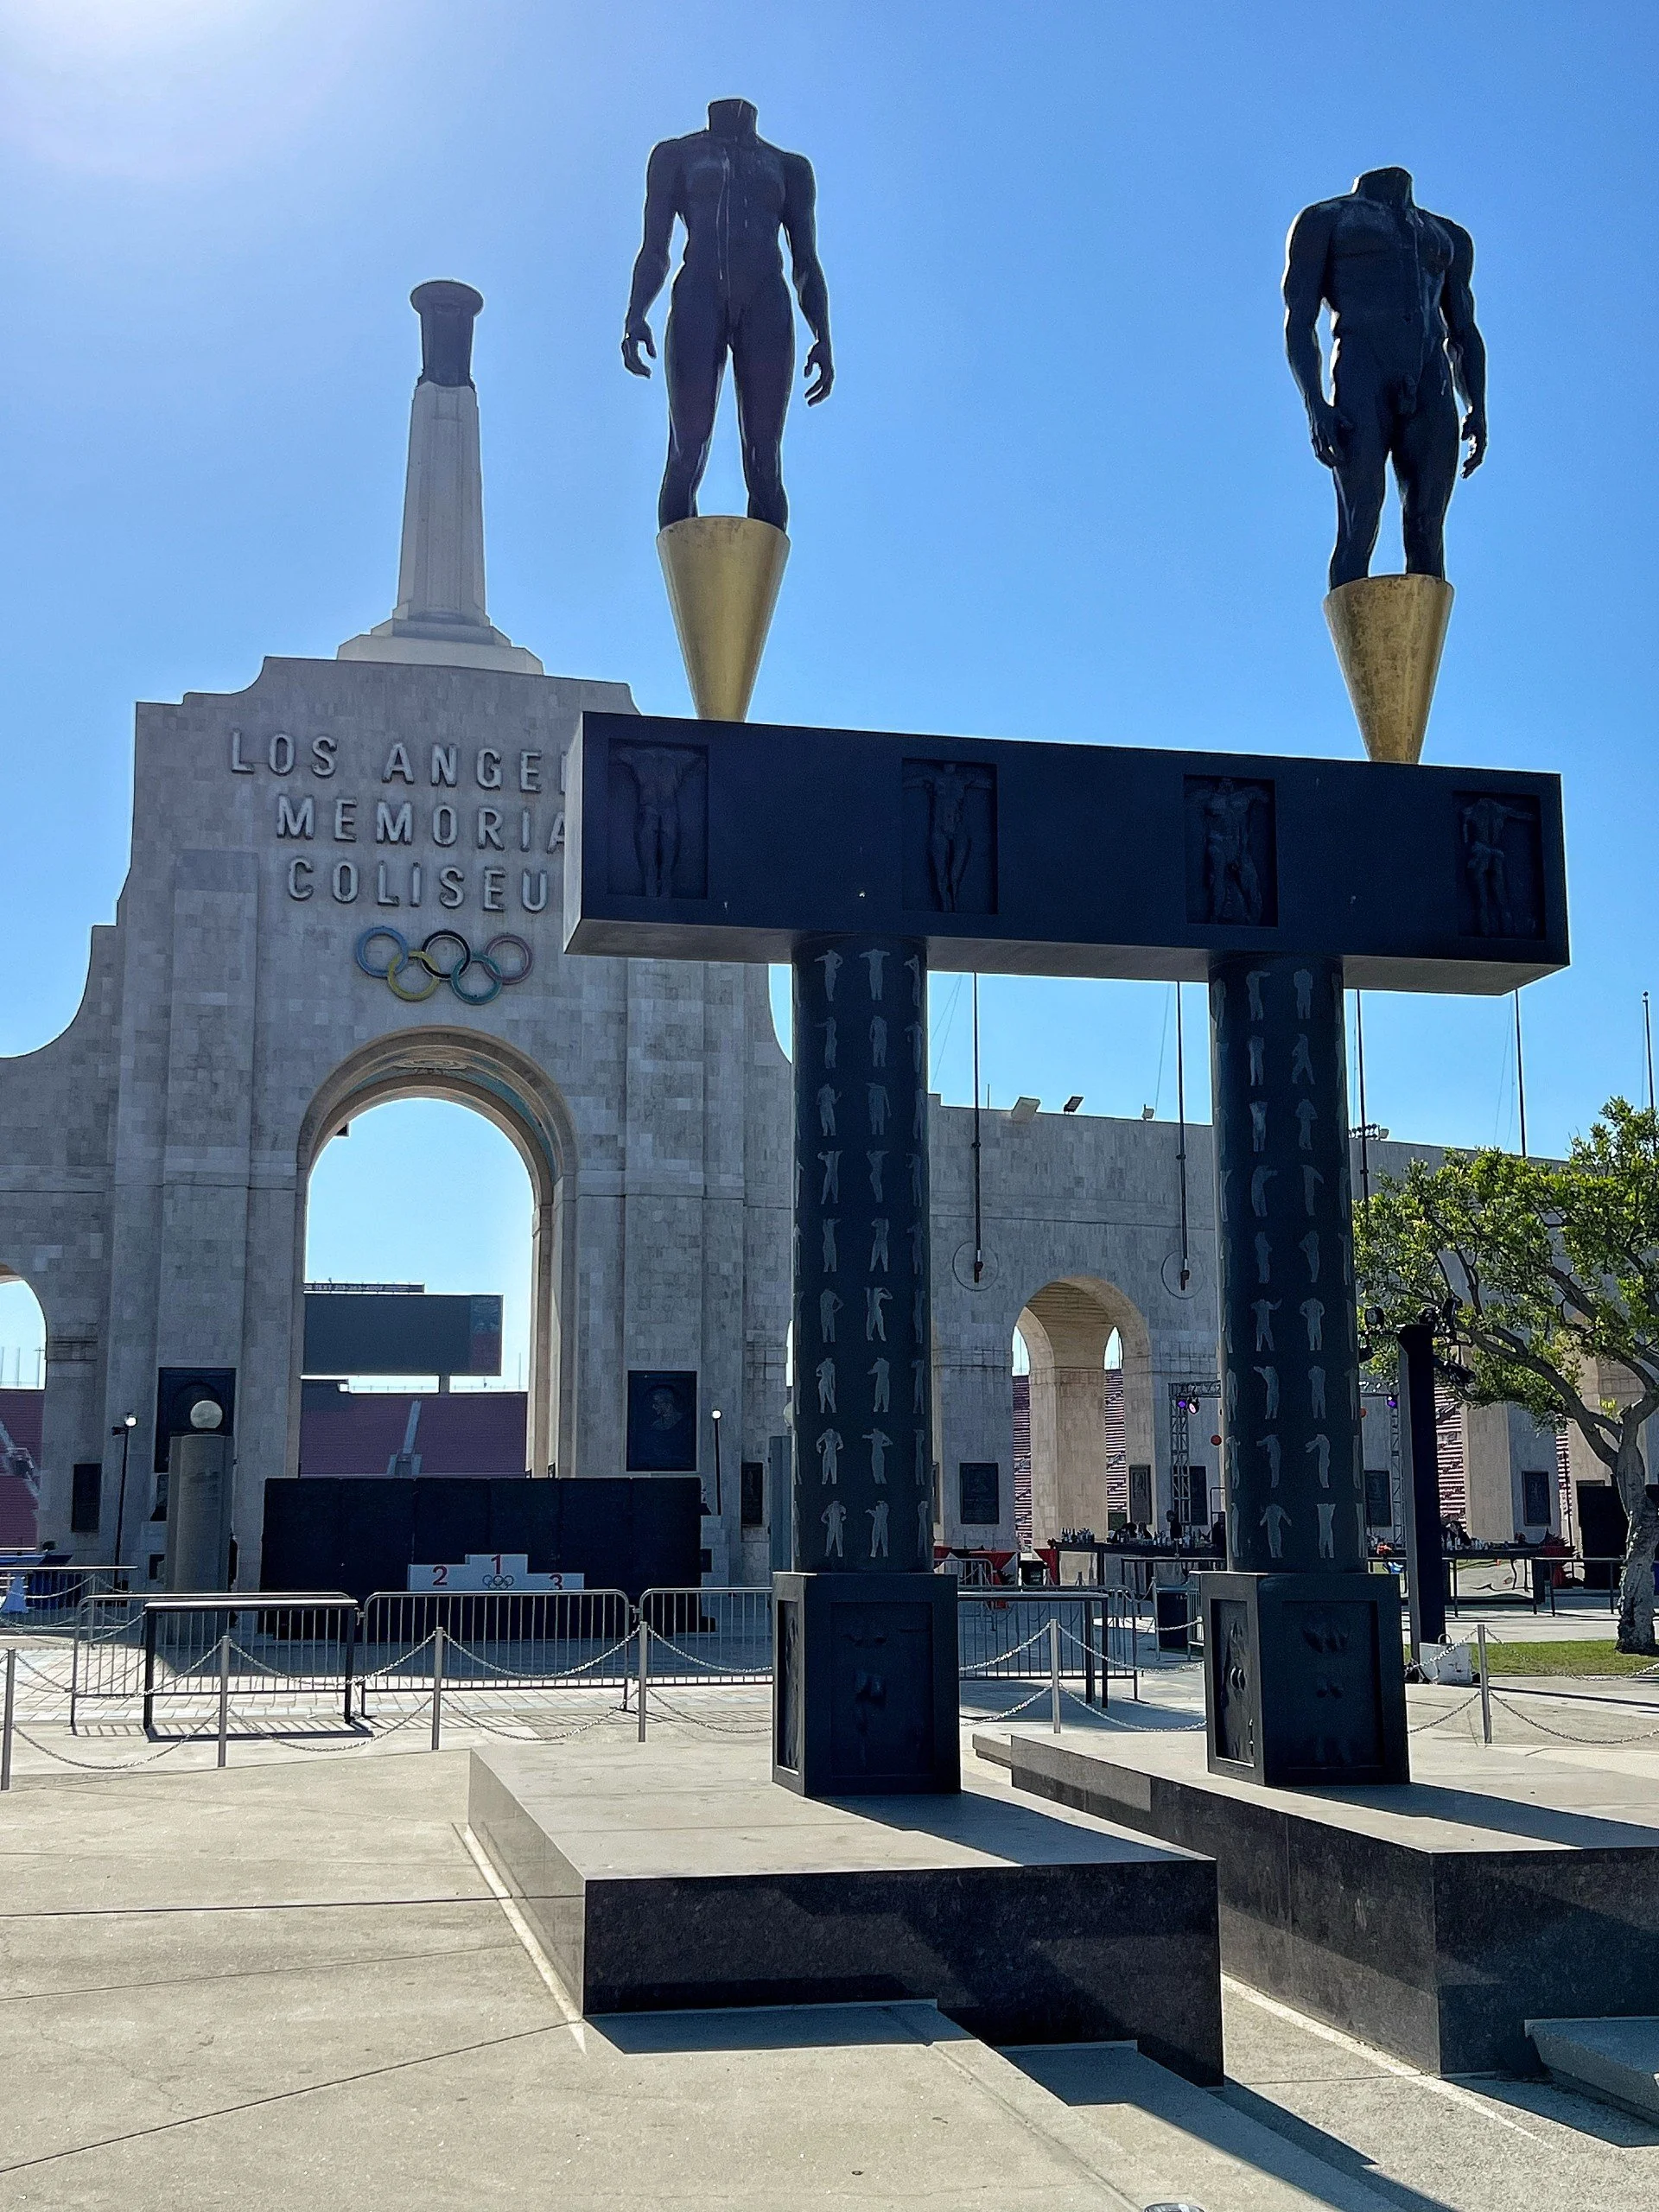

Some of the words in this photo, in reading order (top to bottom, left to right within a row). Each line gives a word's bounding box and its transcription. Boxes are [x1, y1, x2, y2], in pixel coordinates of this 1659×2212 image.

[231, 728, 339, 778] LOS
[288, 855, 548, 914] COLISEU
[490, 1554, 502, 1575] 1
[432, 1565, 448, 1586] 2
[549, 1573, 563, 1590] 3
